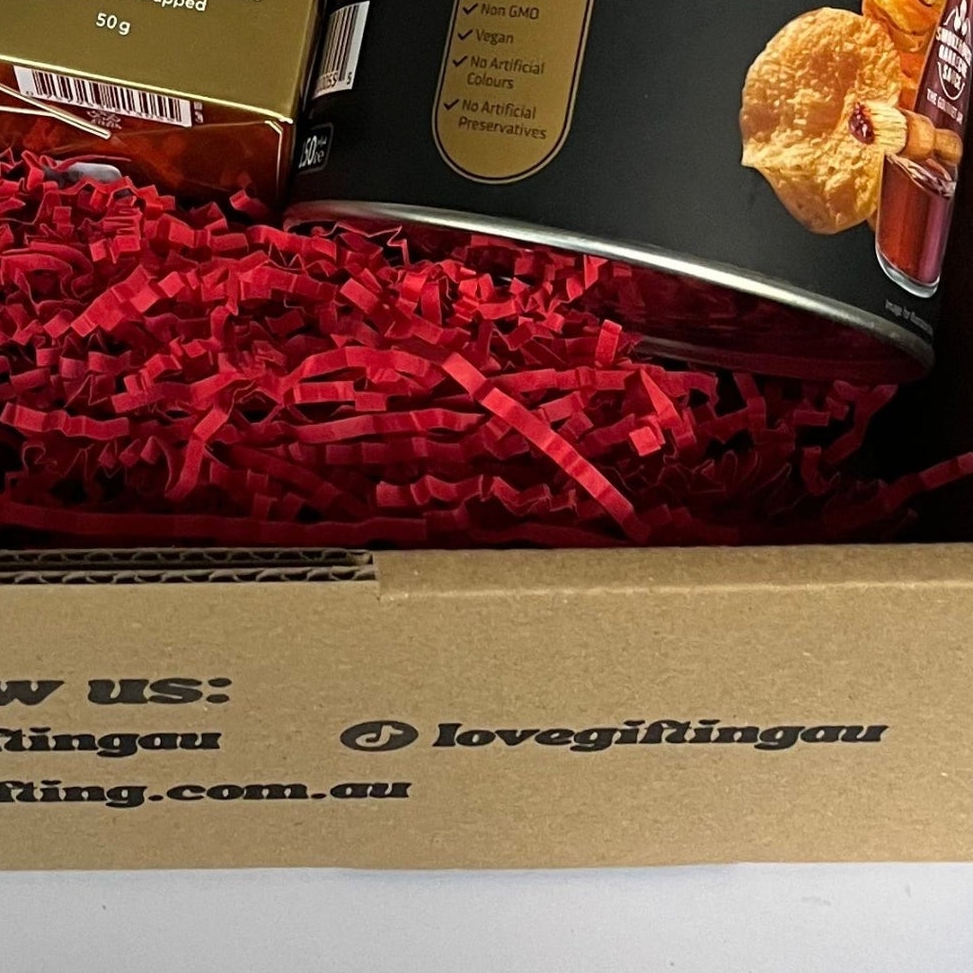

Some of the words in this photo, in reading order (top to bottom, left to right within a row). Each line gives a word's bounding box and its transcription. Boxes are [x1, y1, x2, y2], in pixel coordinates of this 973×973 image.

[480, 3, 506, 18] Non
[508, 5, 540, 20] GMO
[475, 29, 514, 46] Vegan
[470, 55, 488, 68] No
[490, 57, 545, 75] Artificial
[466, 71, 514, 90] Colours
[461, 99, 479, 112] No
[481, 100, 536, 120] Artificial
[458, 116, 547, 140] Preservatives
[87, 675, 232, 705] us:
[432, 719, 889, 751] lovegiftingau
